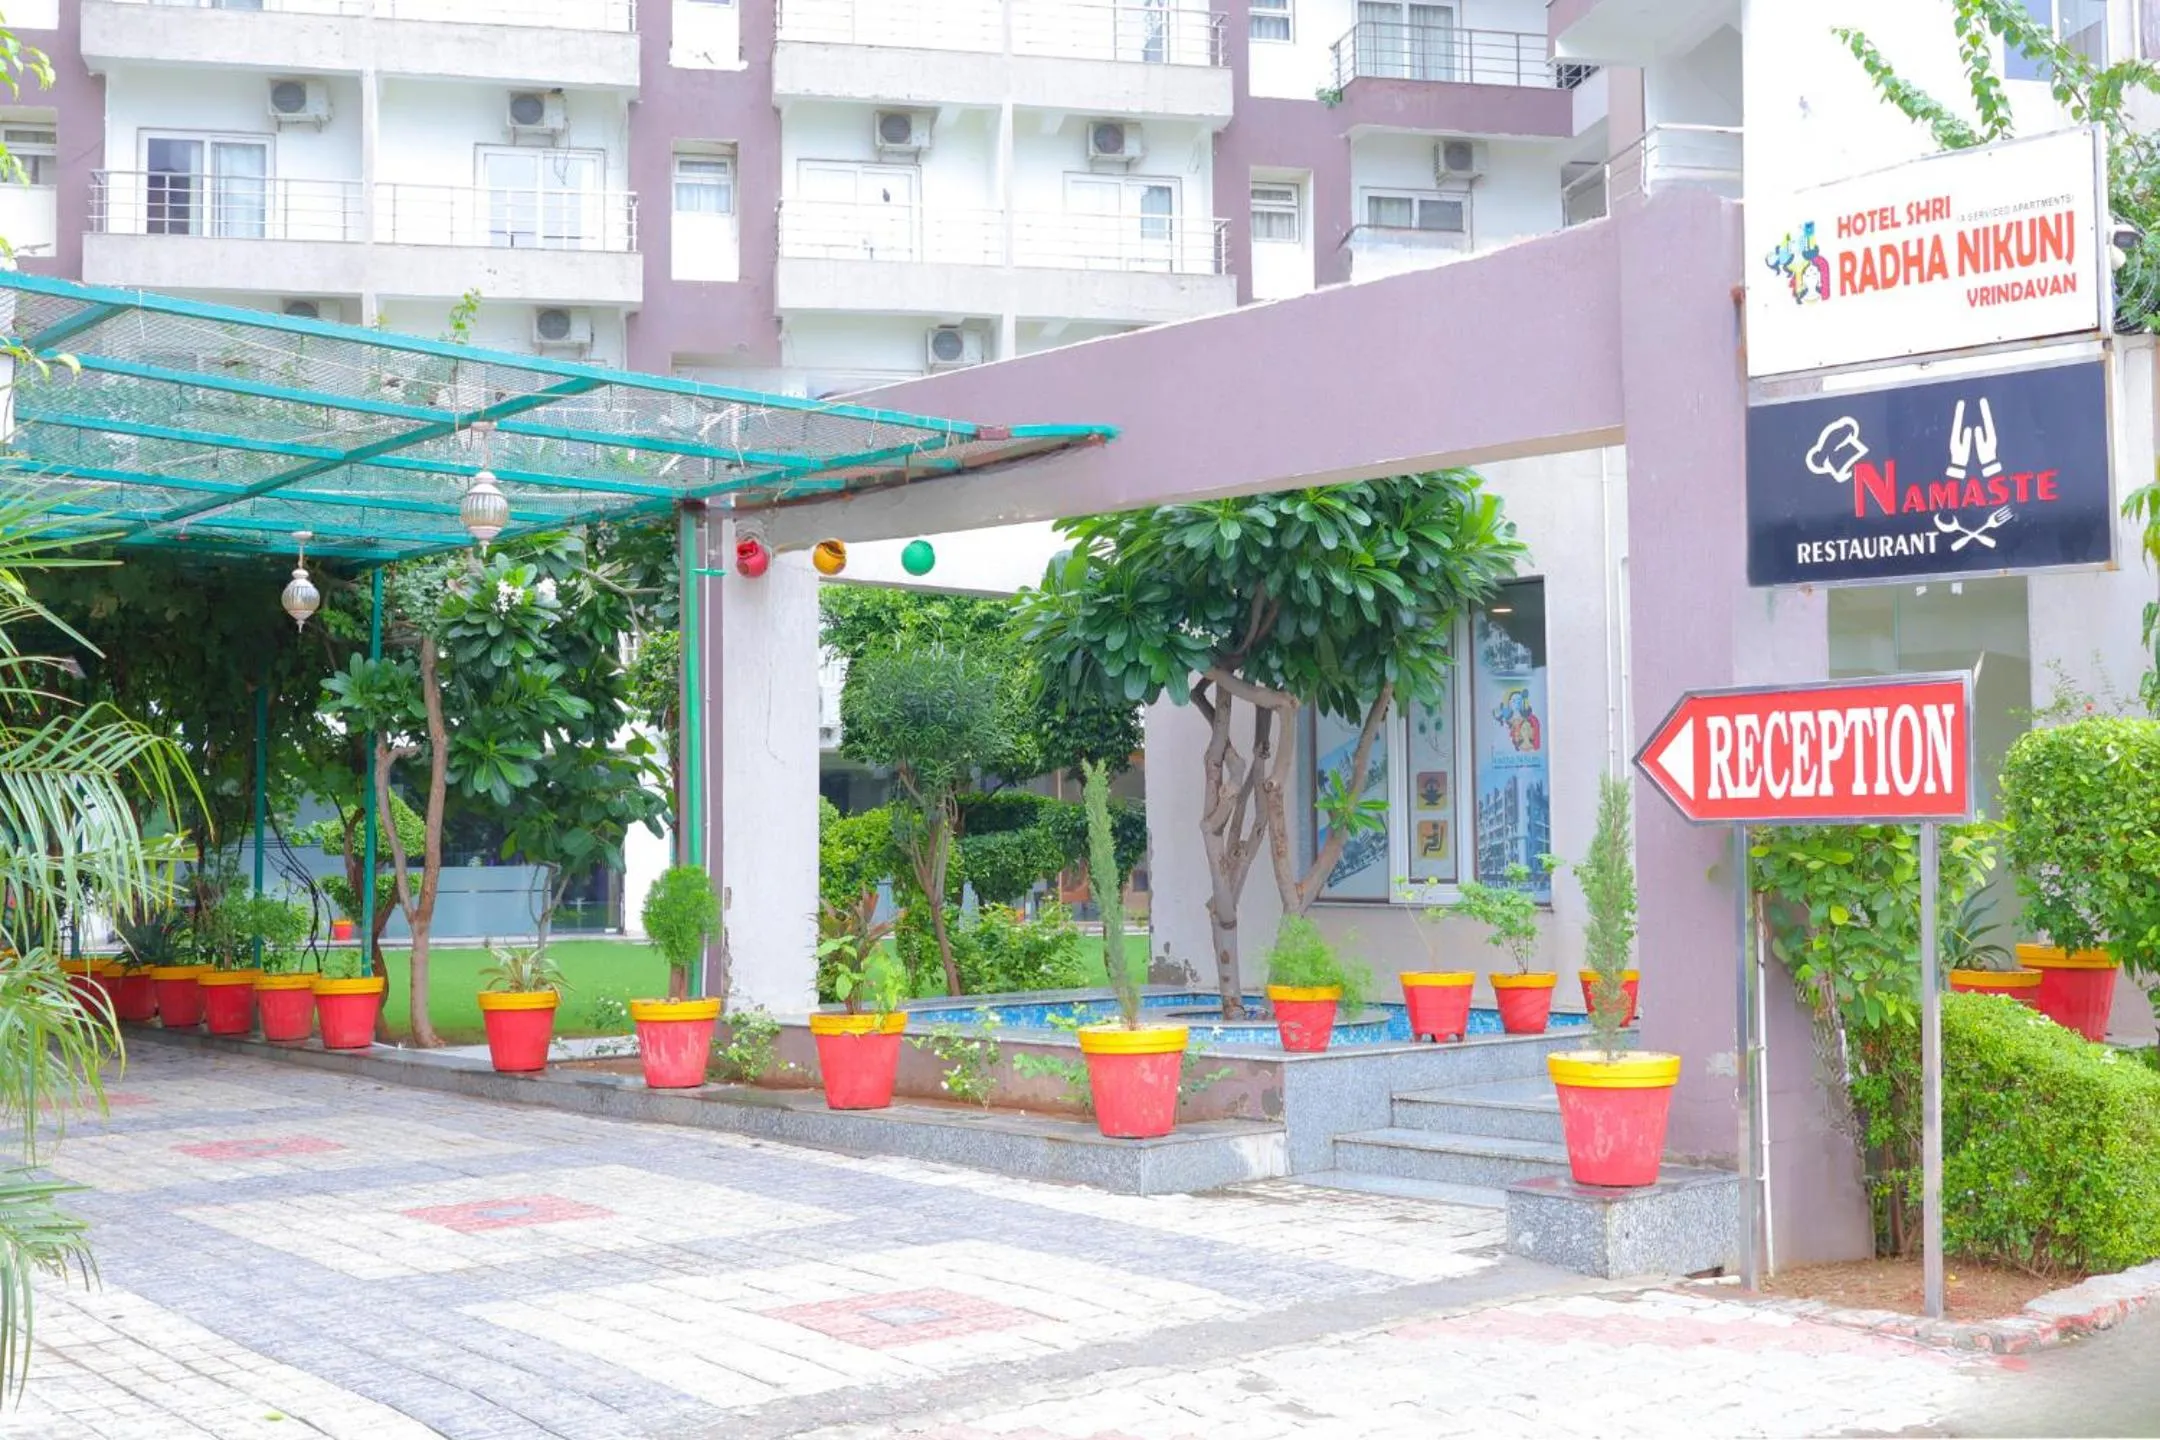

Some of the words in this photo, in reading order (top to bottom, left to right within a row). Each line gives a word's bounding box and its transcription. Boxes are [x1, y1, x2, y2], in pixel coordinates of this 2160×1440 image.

[1837, 207, 1901, 239] HOTEL
[1906, 196, 1951, 225] SHRI
[1838, 234, 1950, 297] RADHA
[1956, 210, 2076, 277] NIKUNJ
[1966, 273, 2077, 308] VRINDAVAN
[1853, 458, 2059, 519] NAMASTE
[1796, 531, 1940, 565] RESTAURANT
[1706, 703, 1956, 800] RECEPTION
